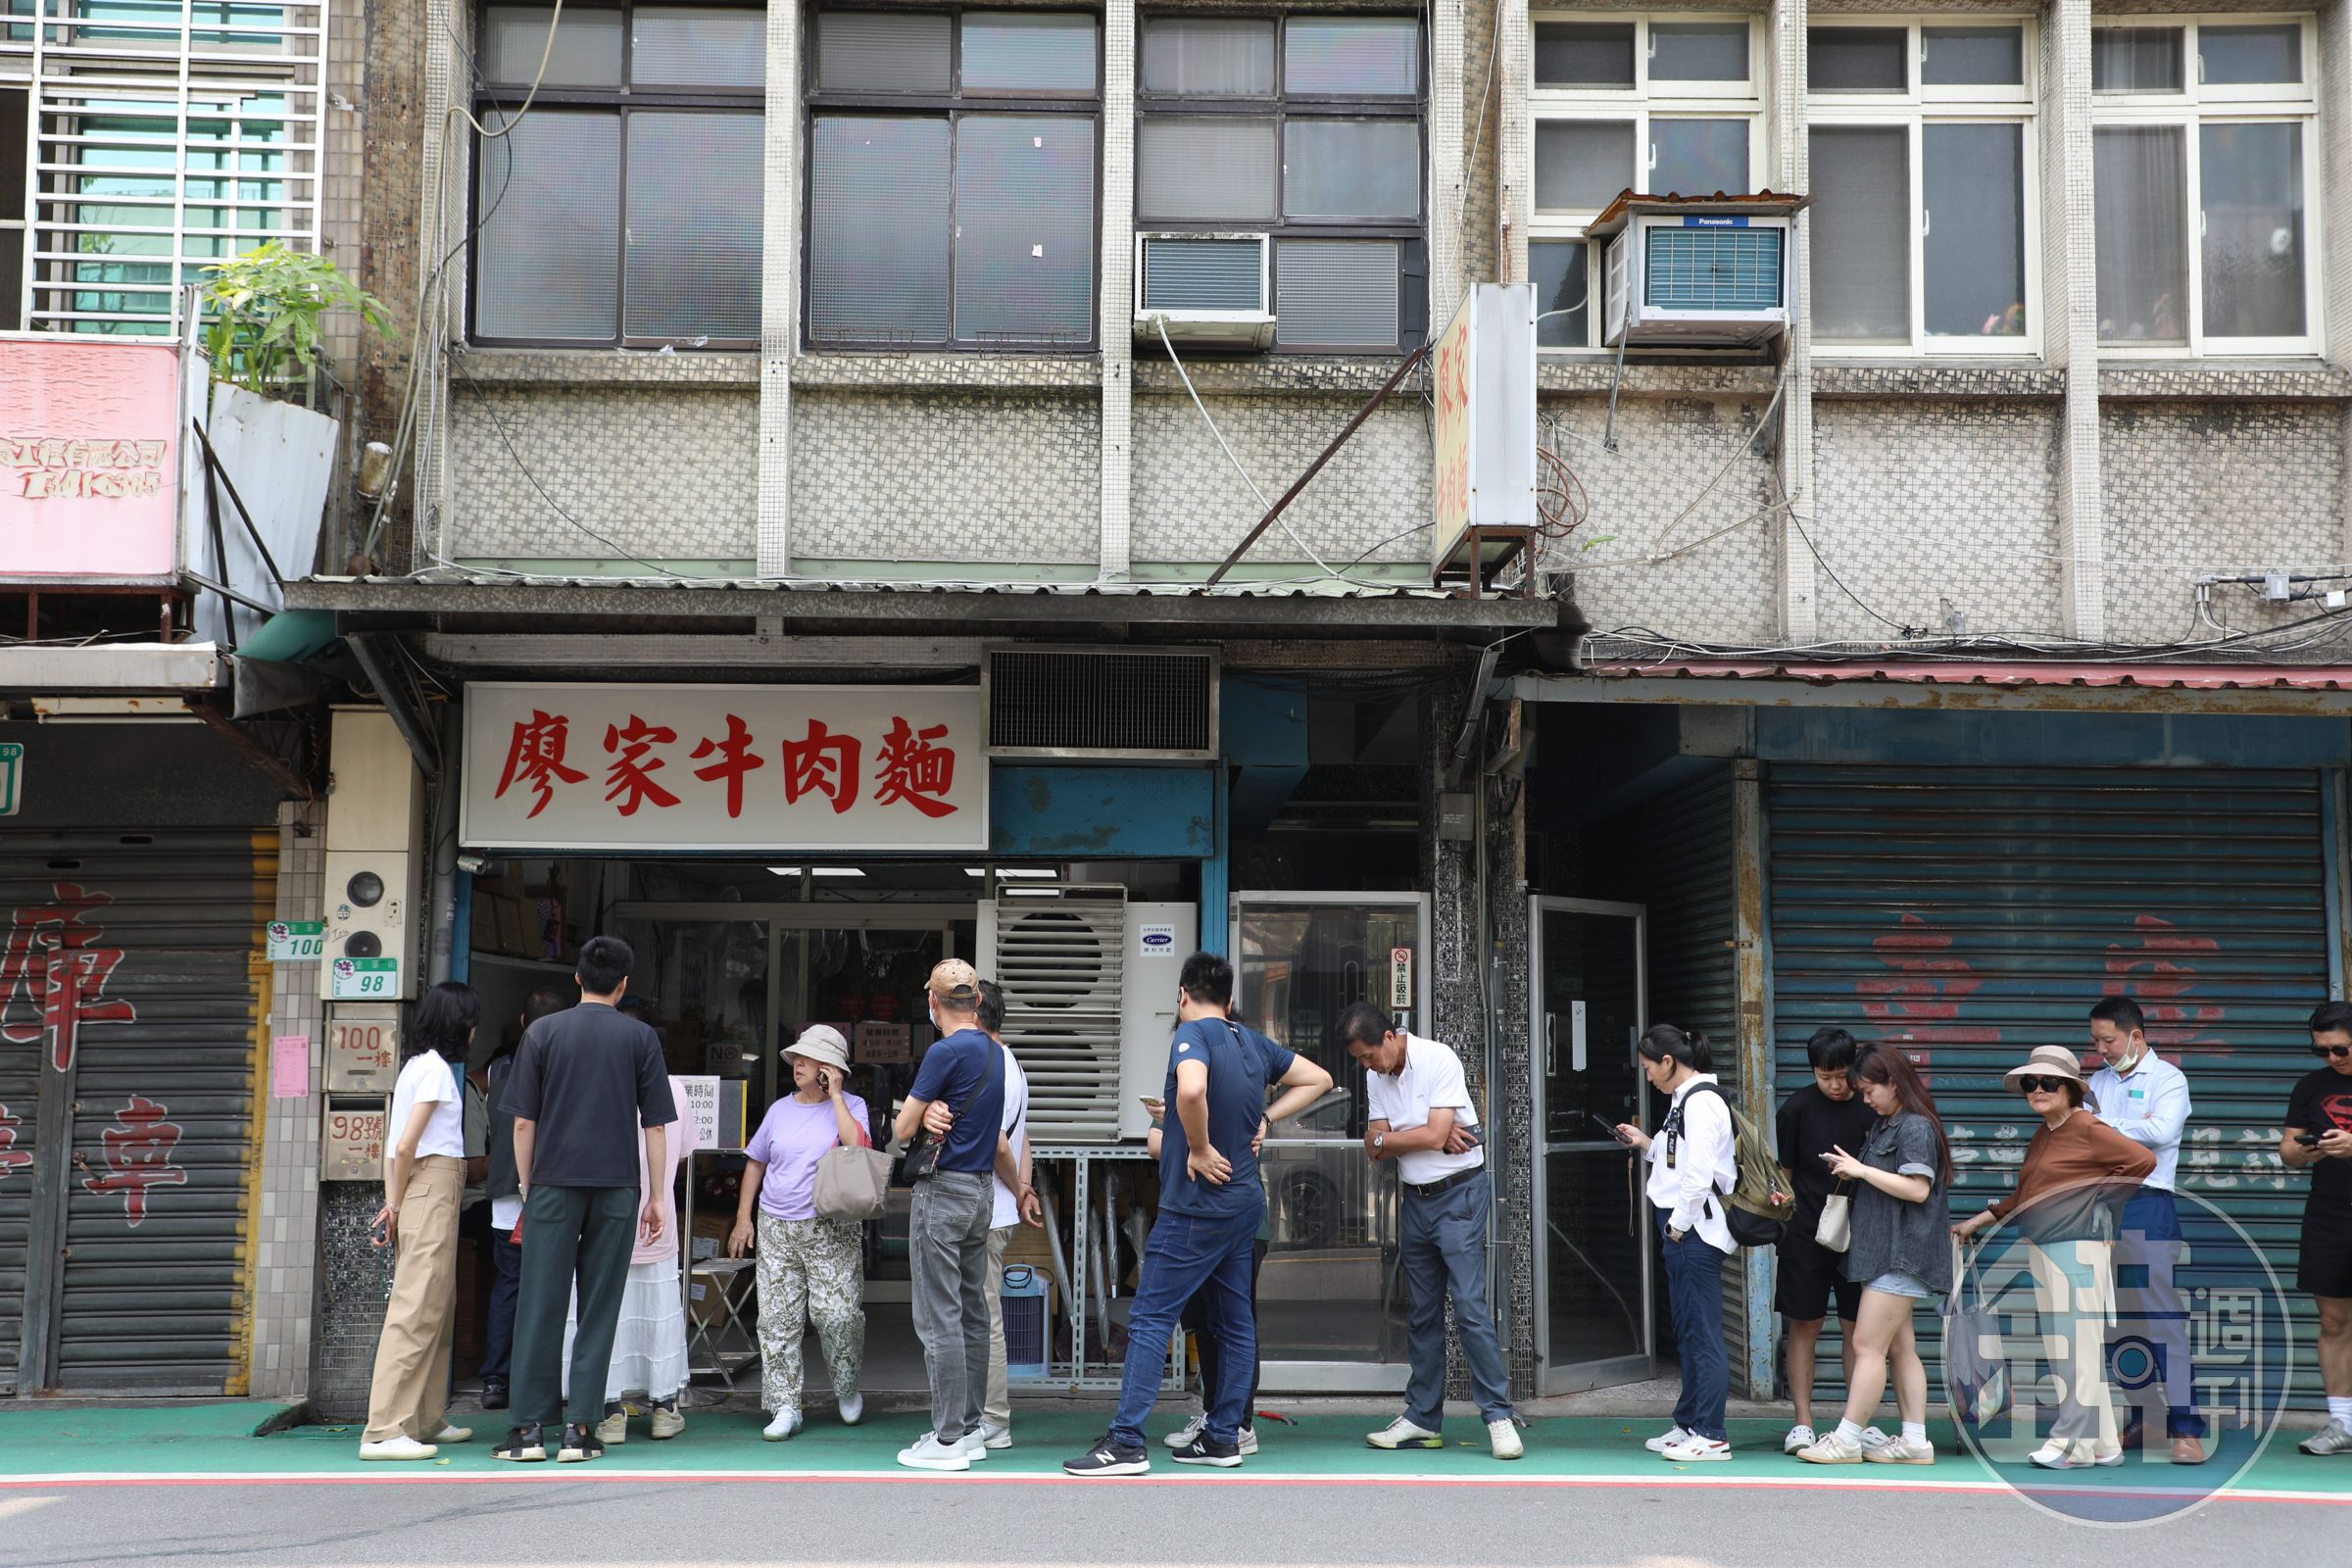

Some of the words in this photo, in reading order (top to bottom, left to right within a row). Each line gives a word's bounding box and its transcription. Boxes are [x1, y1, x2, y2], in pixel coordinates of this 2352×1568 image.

[1438, 322, 1468, 447] 廖家
[1438, 442, 1468, 537] 牛肉麵
[494, 709, 958, 819] 廖家牛肉麵
[290, 939, 323, 956] 100
[360, 975, 384, 992] 98
[1396, 962, 1407, 1004] 禁止吸菸
[339, 1026, 381, 1051] 100
[356, 1051, 392, 1067] 一樓
[690, 1101, 713, 1109] 10:00
[332, 1115, 382, 1141] 98號
[699, 1127, 713, 1141] 公休
[348, 1143, 380, 1159] 一樓
